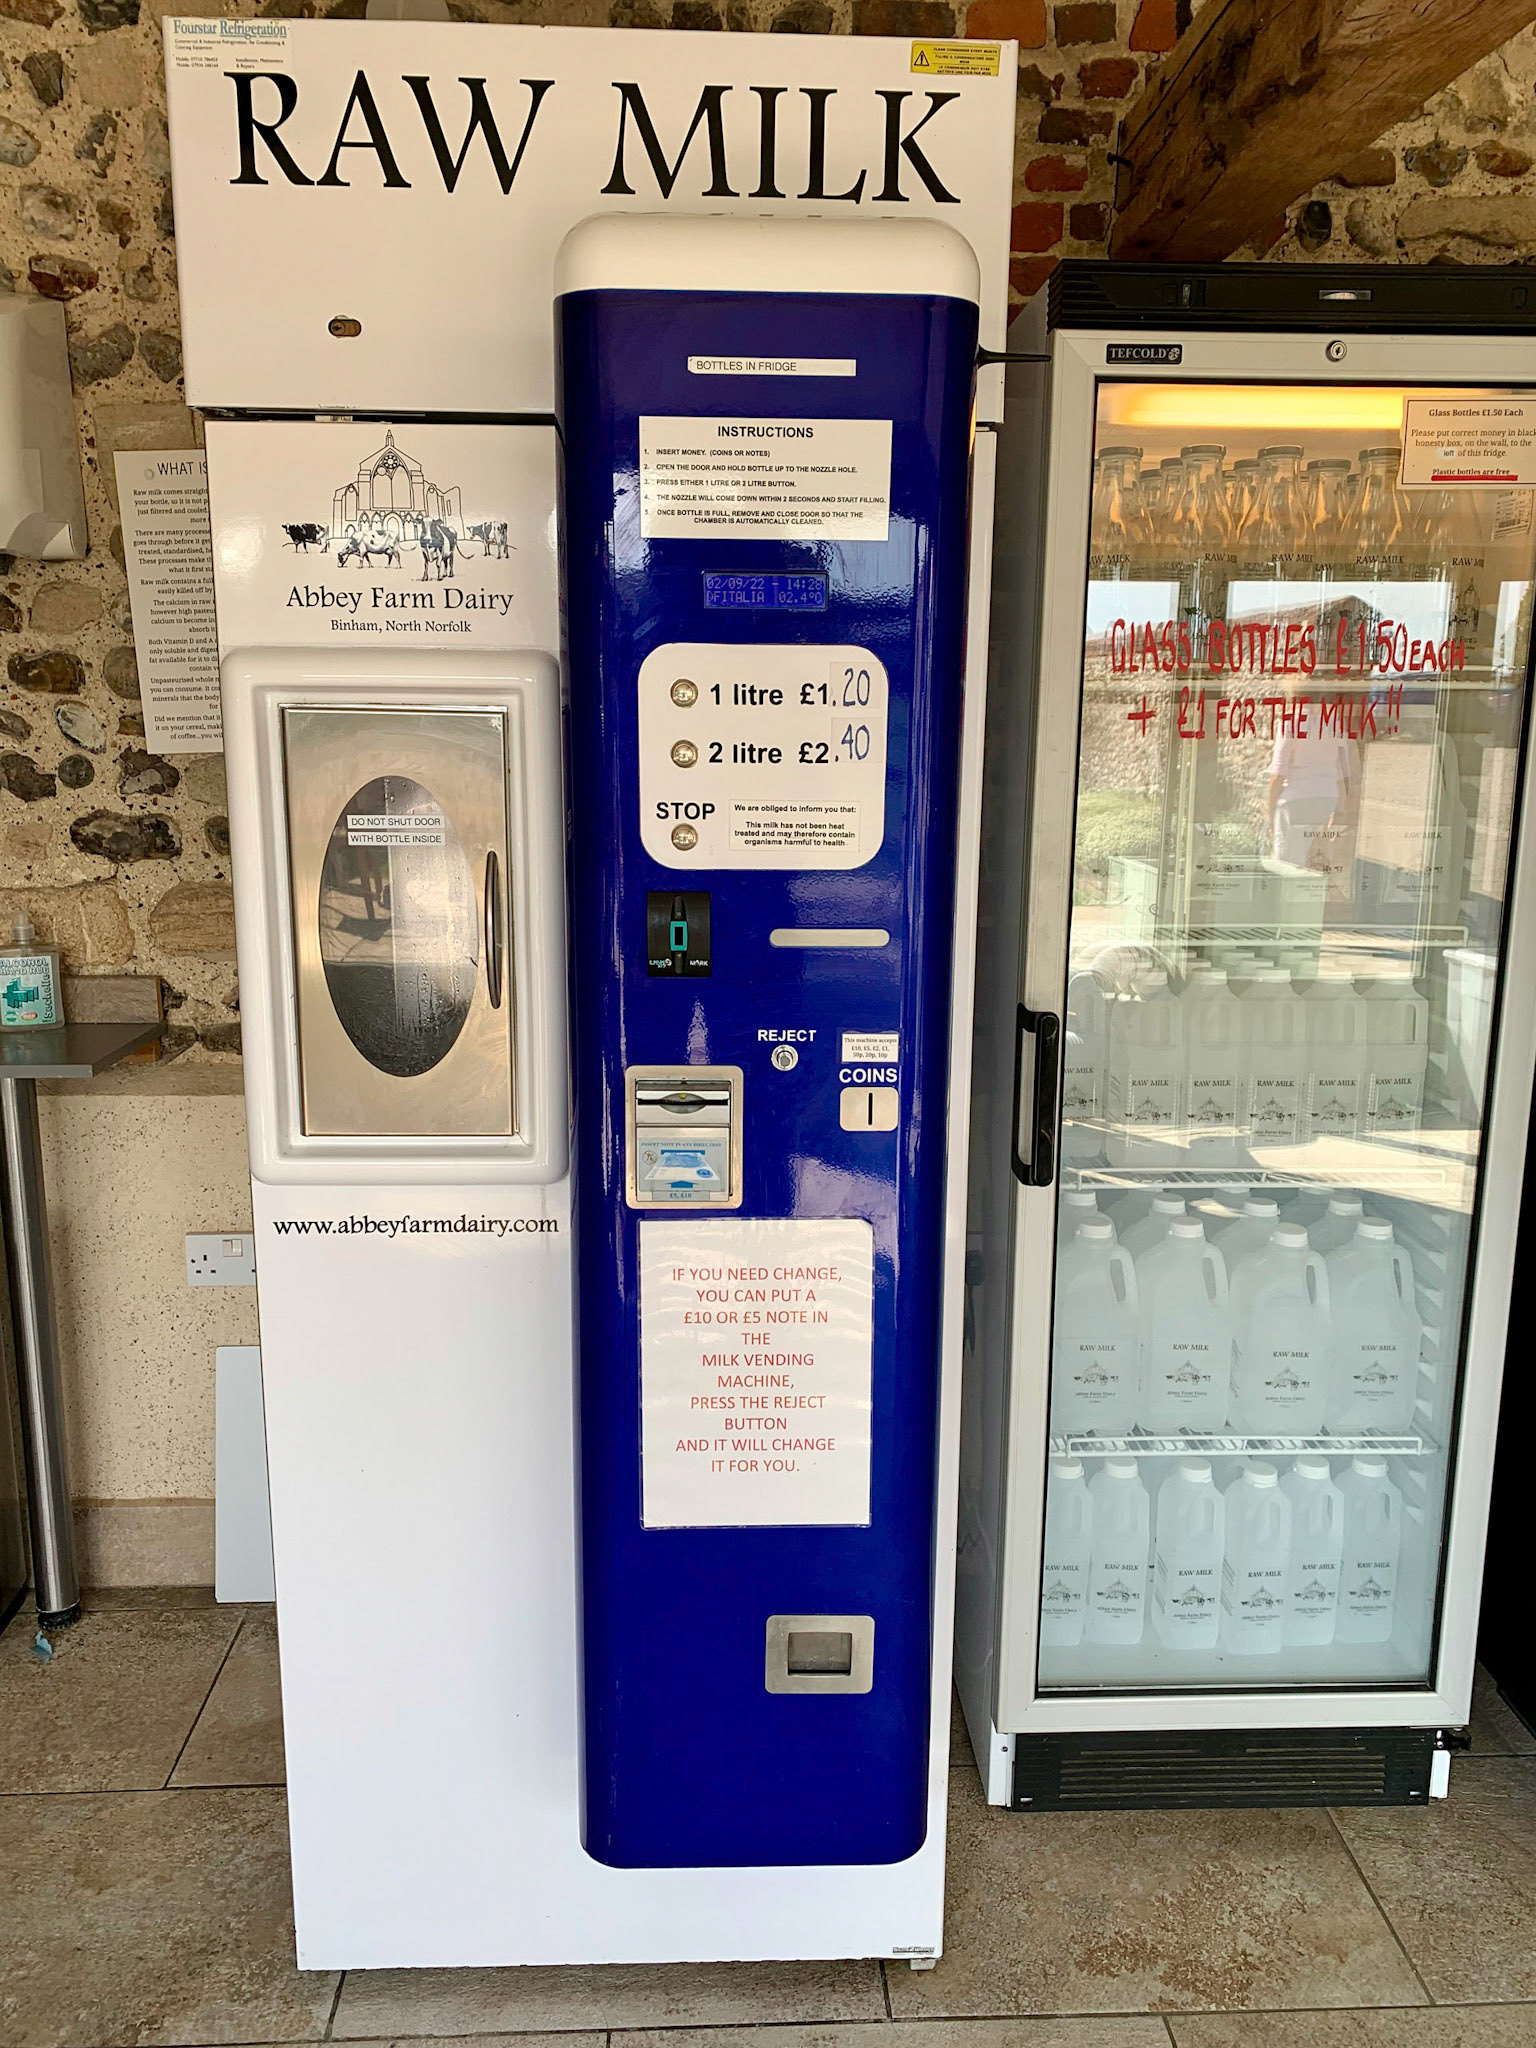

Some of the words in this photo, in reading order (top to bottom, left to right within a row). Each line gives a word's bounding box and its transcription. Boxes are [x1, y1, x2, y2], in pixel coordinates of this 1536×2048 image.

[173, 19, 217, 34] Fourstar
[219, 20, 288, 39] Refrigeration
[223, 69, 556, 195] RAW
[599, 81, 962, 204] MILK
[1109, 347, 1167, 358] TEFCOLD
[696, 360, 743, 371] BOTTLES
[745, 361, 756, 371] IN
[758, 361, 797, 372] FRIDGE
[1428, 408, 1451, 417] Glass
[1451, 408, 1481, 417] Bottles
[1481, 408, 1503, 417] £1.50
[1503, 408, 1524, 417] Each
[717, 425, 814, 439] INSTRUCTIONS
[1411, 428, 1436, 437] Please
[1436, 429, 1450, 439] put
[1451, 429, 1479, 437] correct
[1479, 429, 1507, 439] money
[1507, 428, 1516, 437] in
[1415, 438, 1446, 448] honesty
[1446, 438, 1463, 448] box,
[1476, 438, 1489, 447] the
[1490, 438, 1509, 448] wall,
[1510, 439, 1519, 447] to
[1519, 438, 1533, 447] the
[681, 448, 707, 456] MONEY.
[709, 449, 733, 457] (COINS
[733, 449, 745, 457] OR
[745, 449, 771, 458] NOTES)
[1457, 448, 1467, 457] of
[1467, 448, 1482, 457] this
[1482, 448, 1508, 459] fridge.
[157, 461, 195, 476] WHAT
[133, 489, 147, 497] Raw
[148, 488, 163, 496] milk
[1356, 555, 1380, 565] RAW
[1452, 557, 1473, 567] RAW
[706, 577, 765, 589] 02/09/22
[787, 578, 823, 590] 14:28
[285, 584, 364, 614] Abbey
[370, 586, 436, 609] Farm
[443, 587, 514, 616] Dairy
[706, 590, 766, 603] DFITALIA
[330, 618, 383, 634] Binham,
[385, 619, 422, 632] North
[424, 620, 472, 633] Norfolk
[148, 638, 163, 646] Both
[188, 637, 195, 645] D
[195, 636, 208, 644] and
[1111, 618, 1192, 673] GLASS
[1208, 619, 1317, 674] BOTTLES
[709, 683, 721, 705] 1
[733, 683, 784, 705] litre
[1216, 699, 1256, 739] FOR
[1263, 696, 1308, 740] THE
[708, 742, 723, 763] 2
[732, 742, 783, 764] litre
[655, 802, 716, 820] STOP
[734, 804, 746, 812] We
[760, 804, 789, 814] obliged
[798, 805, 823, 813] inform
[824, 807, 839, 815] you
[351, 817, 366, 826] DO
[366, 817, 386, 826] NOT
[387, 817, 413, 826] SHUT
[414, 817, 441, 826] DOOR
[745, 821, 762, 829] This
[763, 821, 779, 829] milk
[780, 821, 794, 829] has
[808, 822, 827, 830] been
[828, 822, 845, 830] heat
[350, 834, 374, 844] WITH
[375, 834, 411, 843] BOTTLE
[412, 834, 442, 844] INSIDE
[734, 829, 760, 837] treated
[776, 831, 793, 839] may
[793, 830, 827, 838] therefore
[757, 1029, 817, 1042] REJECT
[838, 1067, 898, 1084] COINS
[1256, 1079, 1275, 1087] RAW
[1275, 1080, 1295, 1088] MILK
[272, 1215, 560, 1239] www.abbeyfarmdairy.com
[672, 1267, 686, 1281] IF
[690, 1267, 723, 1281] YOU
[727, 1267, 769, 1281] NEED
[773, 1266, 842, 1282] CHANGE,
[696, 1287, 730, 1304] YOU
[733, 1288, 767, 1304] CAN
[770, 1287, 801, 1303] PUT
[805, 1288, 817, 1302] A
[683, 1311, 713, 1325] £10
[715, 1310, 739, 1324] OR
[743, 1310, 762, 1325] £5
[765, 1309, 808, 1324] NOTE
[812, 1310, 829, 1324] IN
[741, 1332, 771, 1345] THE
[1079, 1344, 1096, 1352] RAW
[1097, 1344, 1116, 1352] MILK
[701, 1353, 740, 1367] MILK
[744, 1352, 815, 1367] VENDING
[716, 1374, 794, 1389] MACHINE,
[690, 1395, 737, 1409] PRESS
[739, 1394, 769, 1410] THE
[773, 1394, 826, 1409] REJECT
[724, 1416, 788, 1432] BUTTON
[675, 1439, 710, 1452] AND
[714, 1439, 727, 1452] IT
[731, 1439, 769, 1452] WILL
[771, 1437, 835, 1452] CHANGE
[711, 1458, 725, 1473] IT
[727, 1458, 761, 1473] FOR
[762, 1458, 801, 1473] YOU.
[1178, 1569, 1195, 1577] RAW
[1195, 1568, 1213, 1576] MILK
